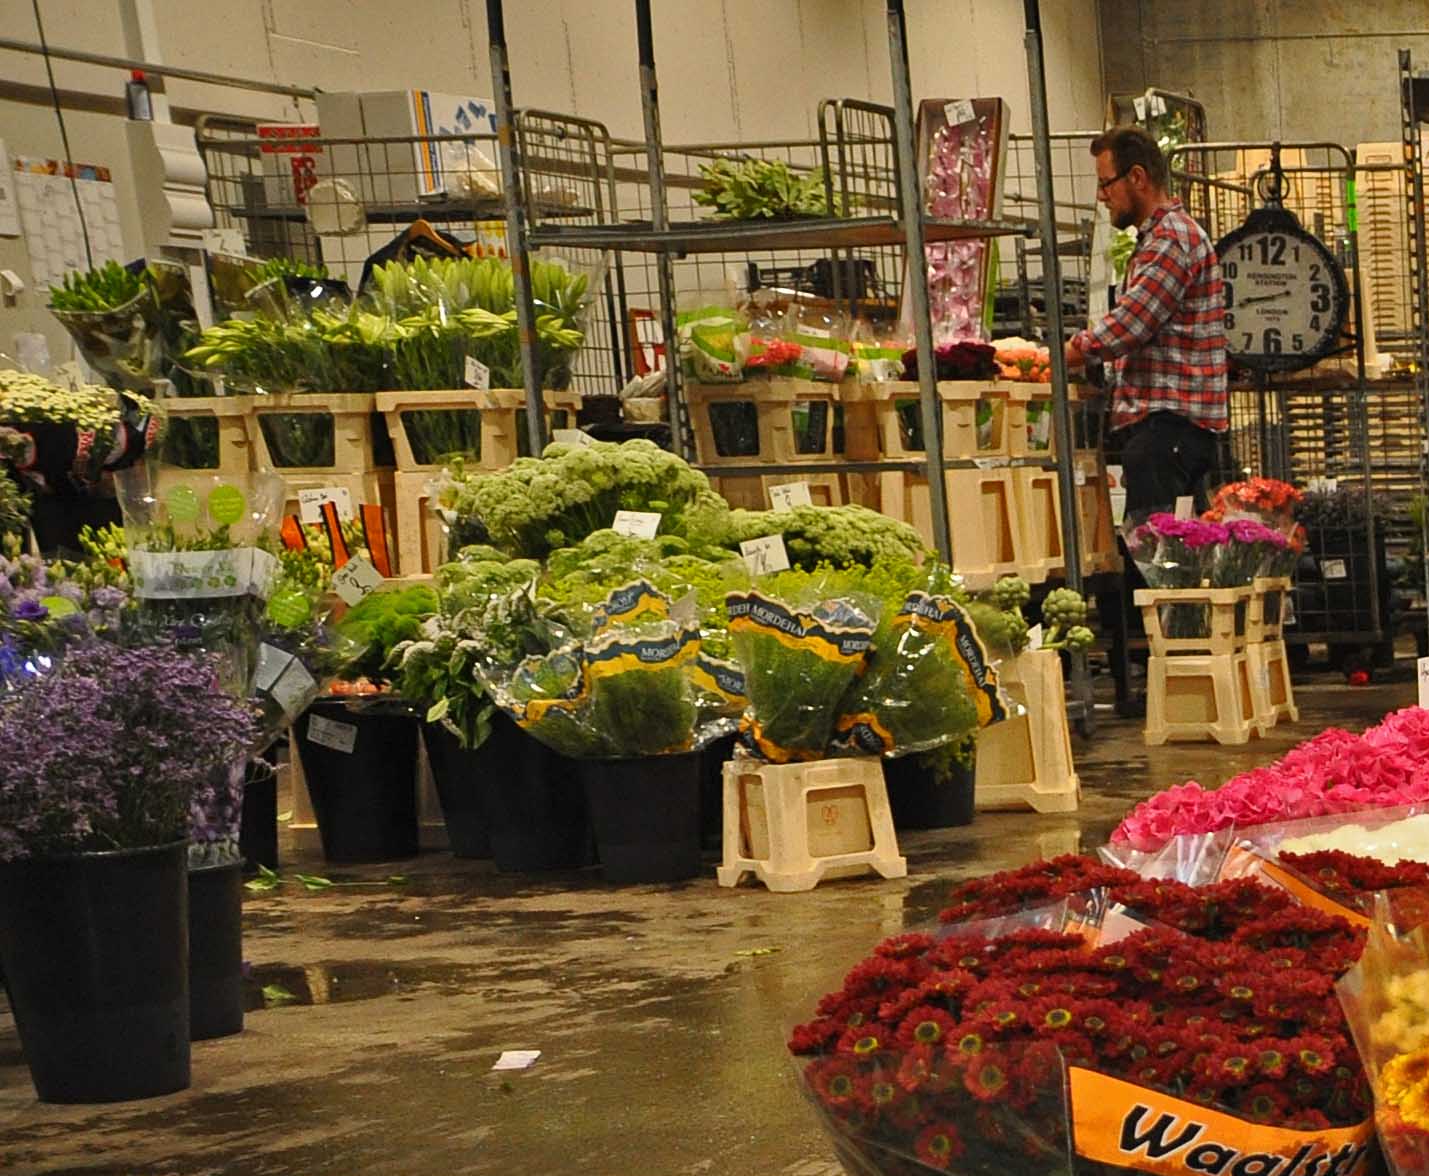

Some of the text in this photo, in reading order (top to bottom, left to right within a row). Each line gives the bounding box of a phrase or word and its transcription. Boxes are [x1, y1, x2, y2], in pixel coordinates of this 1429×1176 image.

[1239, 245, 1253, 262] 11
[1256, 236, 1287, 266] 12
[1292, 245, 1300, 262] 1
[1222, 262, 1238, 279] 10
[1309, 264, 1321, 281] 2
[1310, 284, 1330, 313] 3
[1309, 314, 1320, 332] 4
[1242, 332, 1253, 350] 7
[1263, 328, 1282, 354] 6
[1292, 334, 1303, 351] 5
